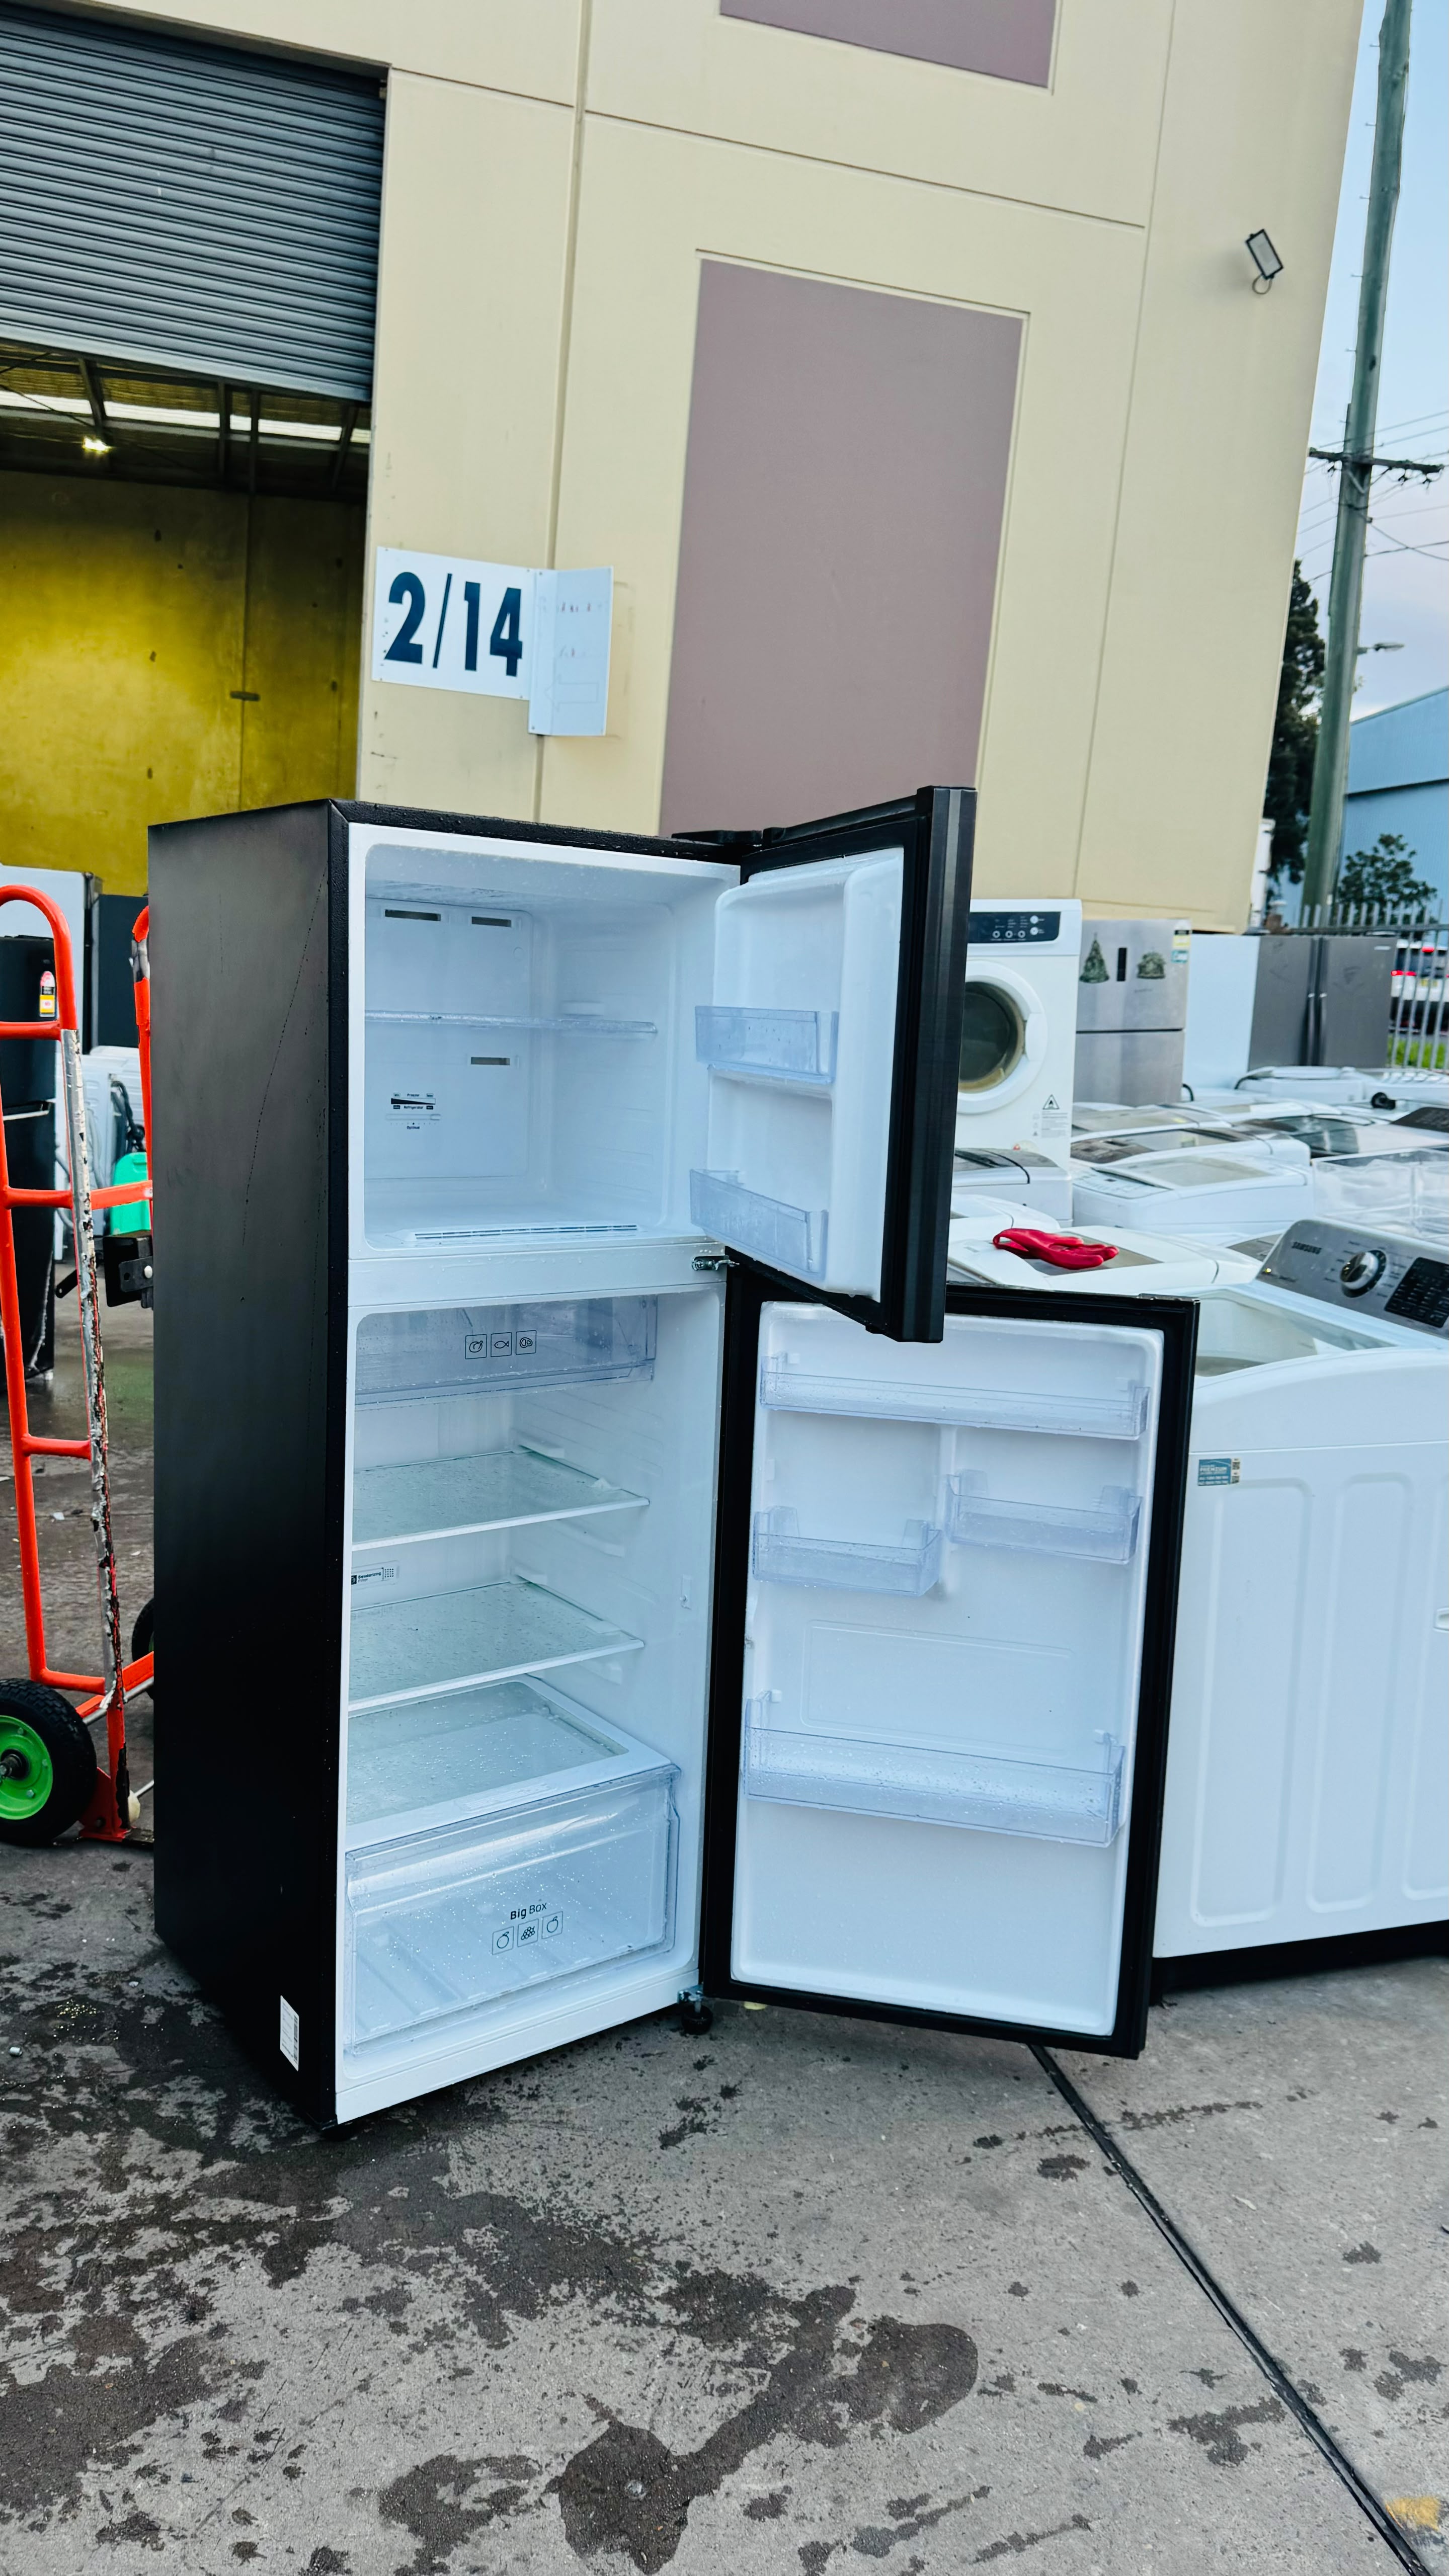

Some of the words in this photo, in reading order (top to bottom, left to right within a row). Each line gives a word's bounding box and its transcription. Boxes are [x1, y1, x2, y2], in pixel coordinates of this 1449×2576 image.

[384, 572, 523, 677] 2/14
[1291, 1241, 1322, 1254] SAMSUNG
[510, 1908, 527, 1920] Big
[529, 1903, 547, 1914] Box
